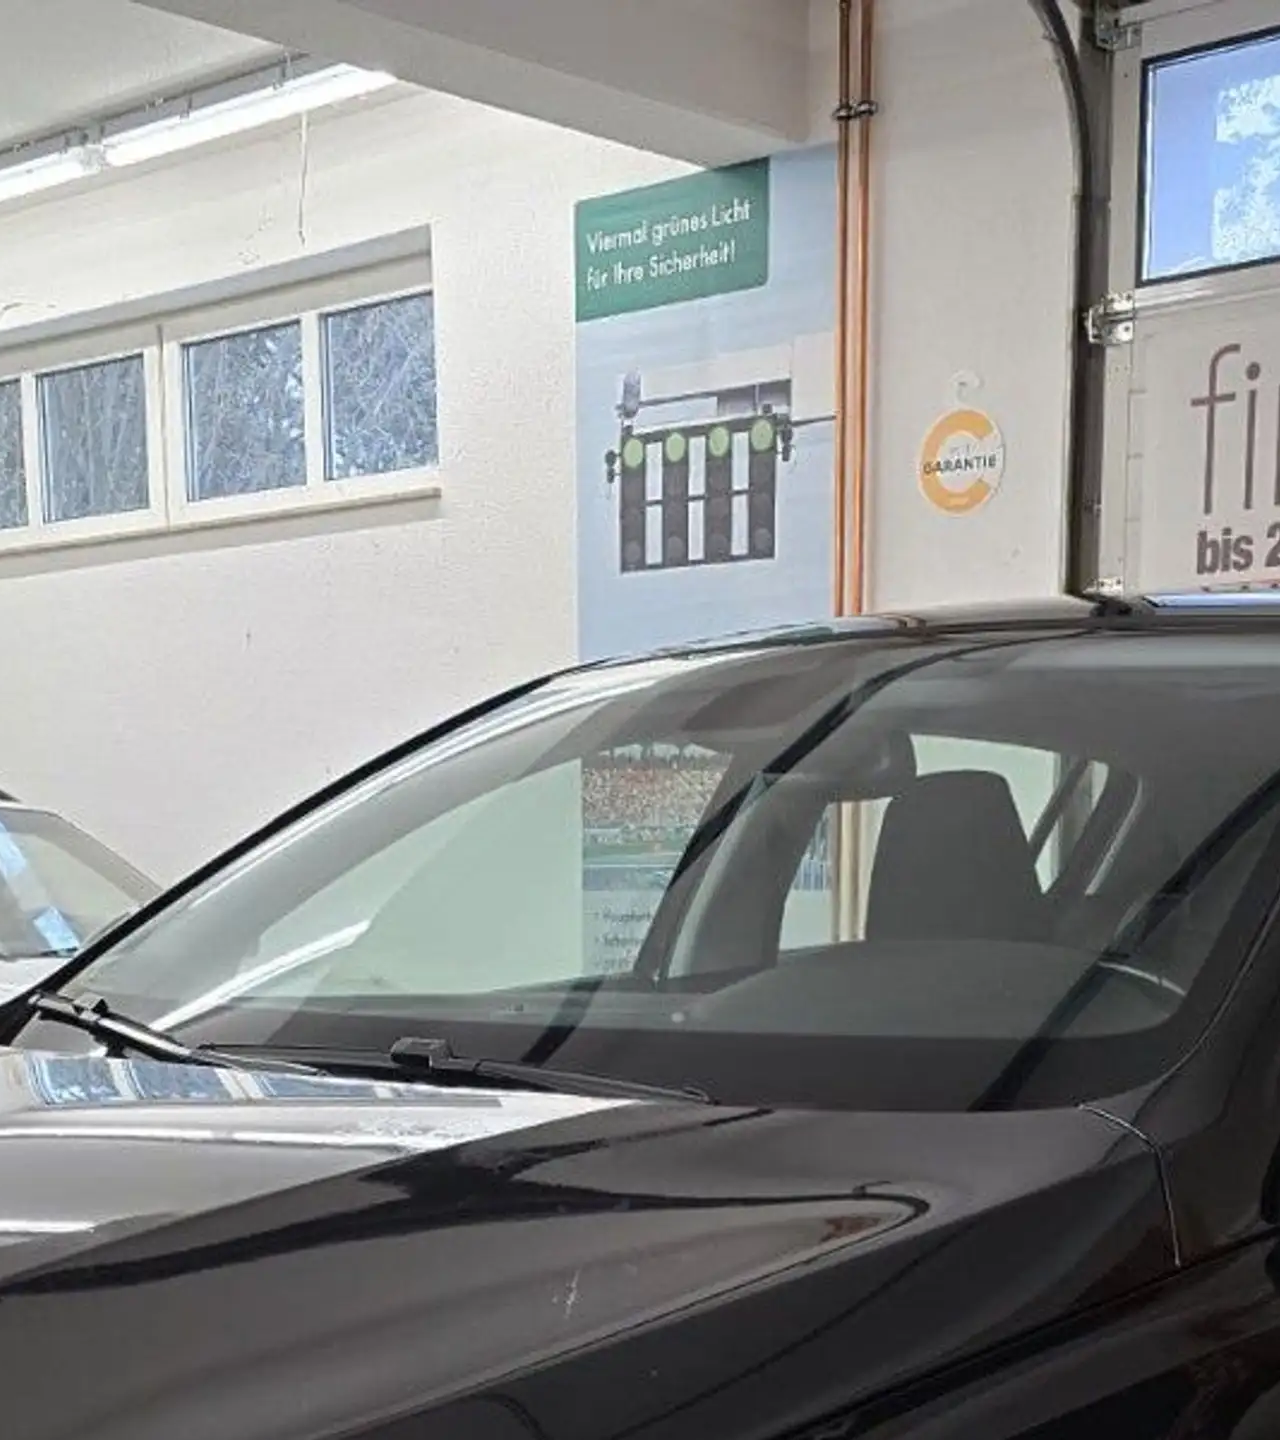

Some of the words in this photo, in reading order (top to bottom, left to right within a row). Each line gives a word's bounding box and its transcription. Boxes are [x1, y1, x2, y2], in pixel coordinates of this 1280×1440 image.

[586, 219, 648, 254] Viermal
[651, 212, 708, 246] grünes
[711, 197, 751, 226] Licht
[586, 266, 609, 291] für
[613, 261, 645, 284] Ihre
[649, 239, 737, 278] Sicherheit!
[922, 454, 997, 475] GARANTIE
[1196, 526, 1254, 575] bis
